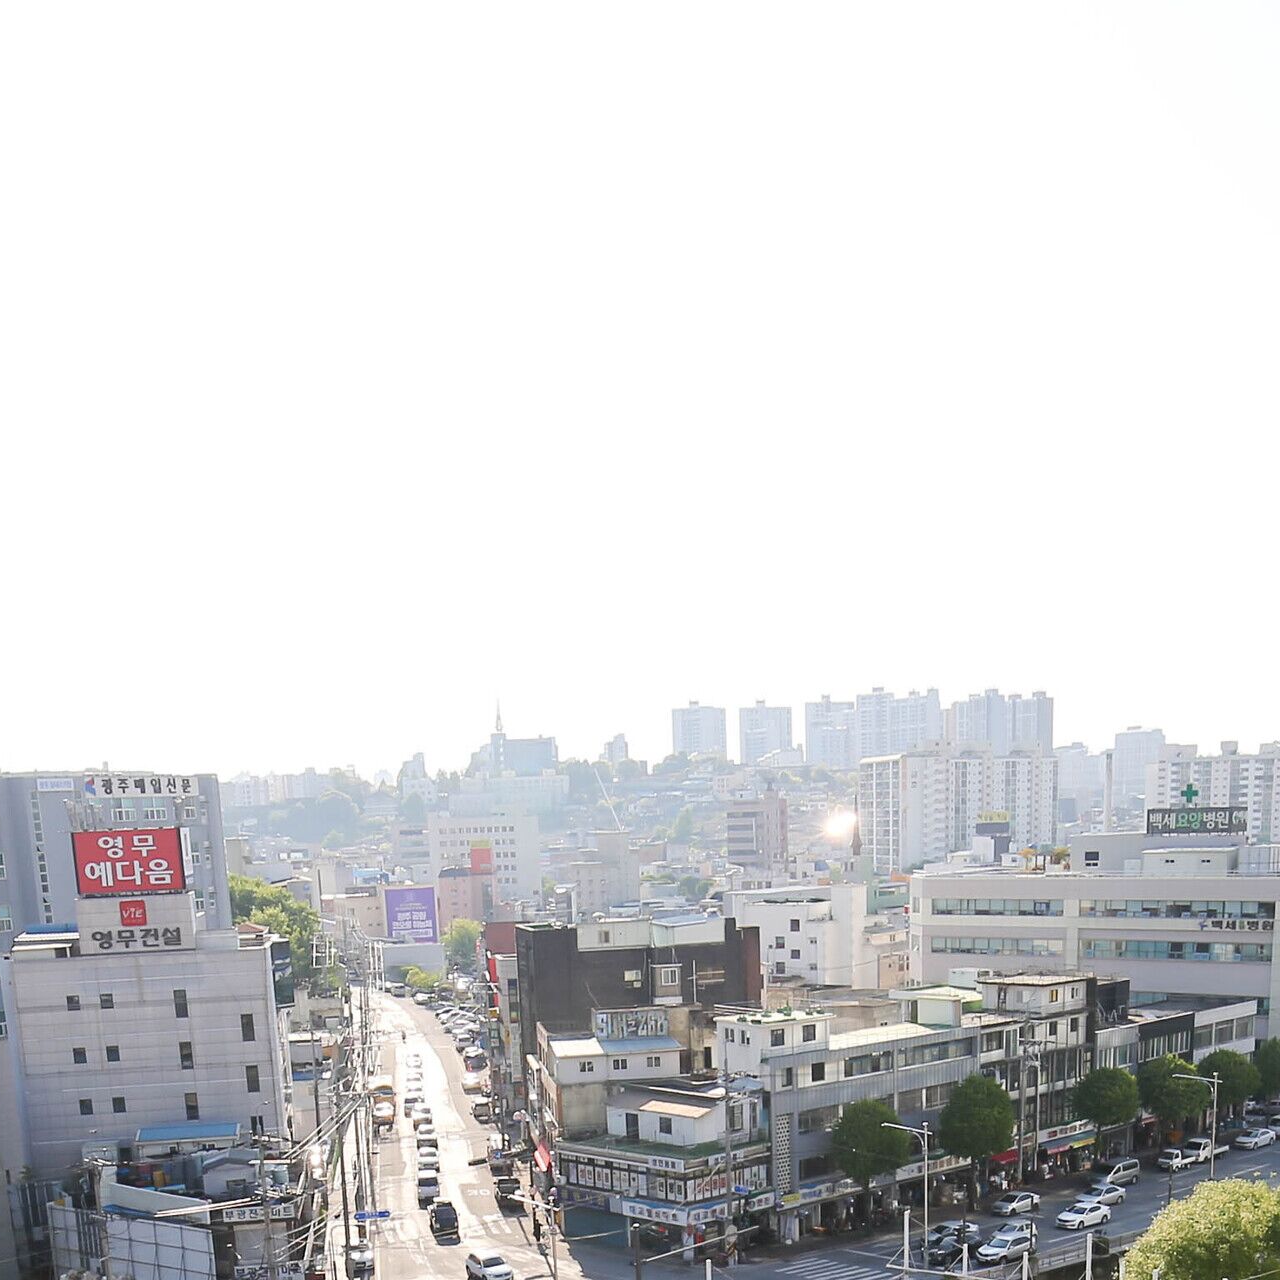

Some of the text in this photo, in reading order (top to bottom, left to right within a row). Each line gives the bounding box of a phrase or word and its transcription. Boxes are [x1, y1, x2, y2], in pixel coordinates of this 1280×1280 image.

[101, 778, 193, 795] 광주매일신문
[1149, 811, 1229, 829] 백세요양병원
[97, 834, 157, 858] 영무
[84, 858, 174, 887] 예다음
[91, 927, 182, 950] 영무건설
[224, 1206, 295, 1221] 부광전마트
